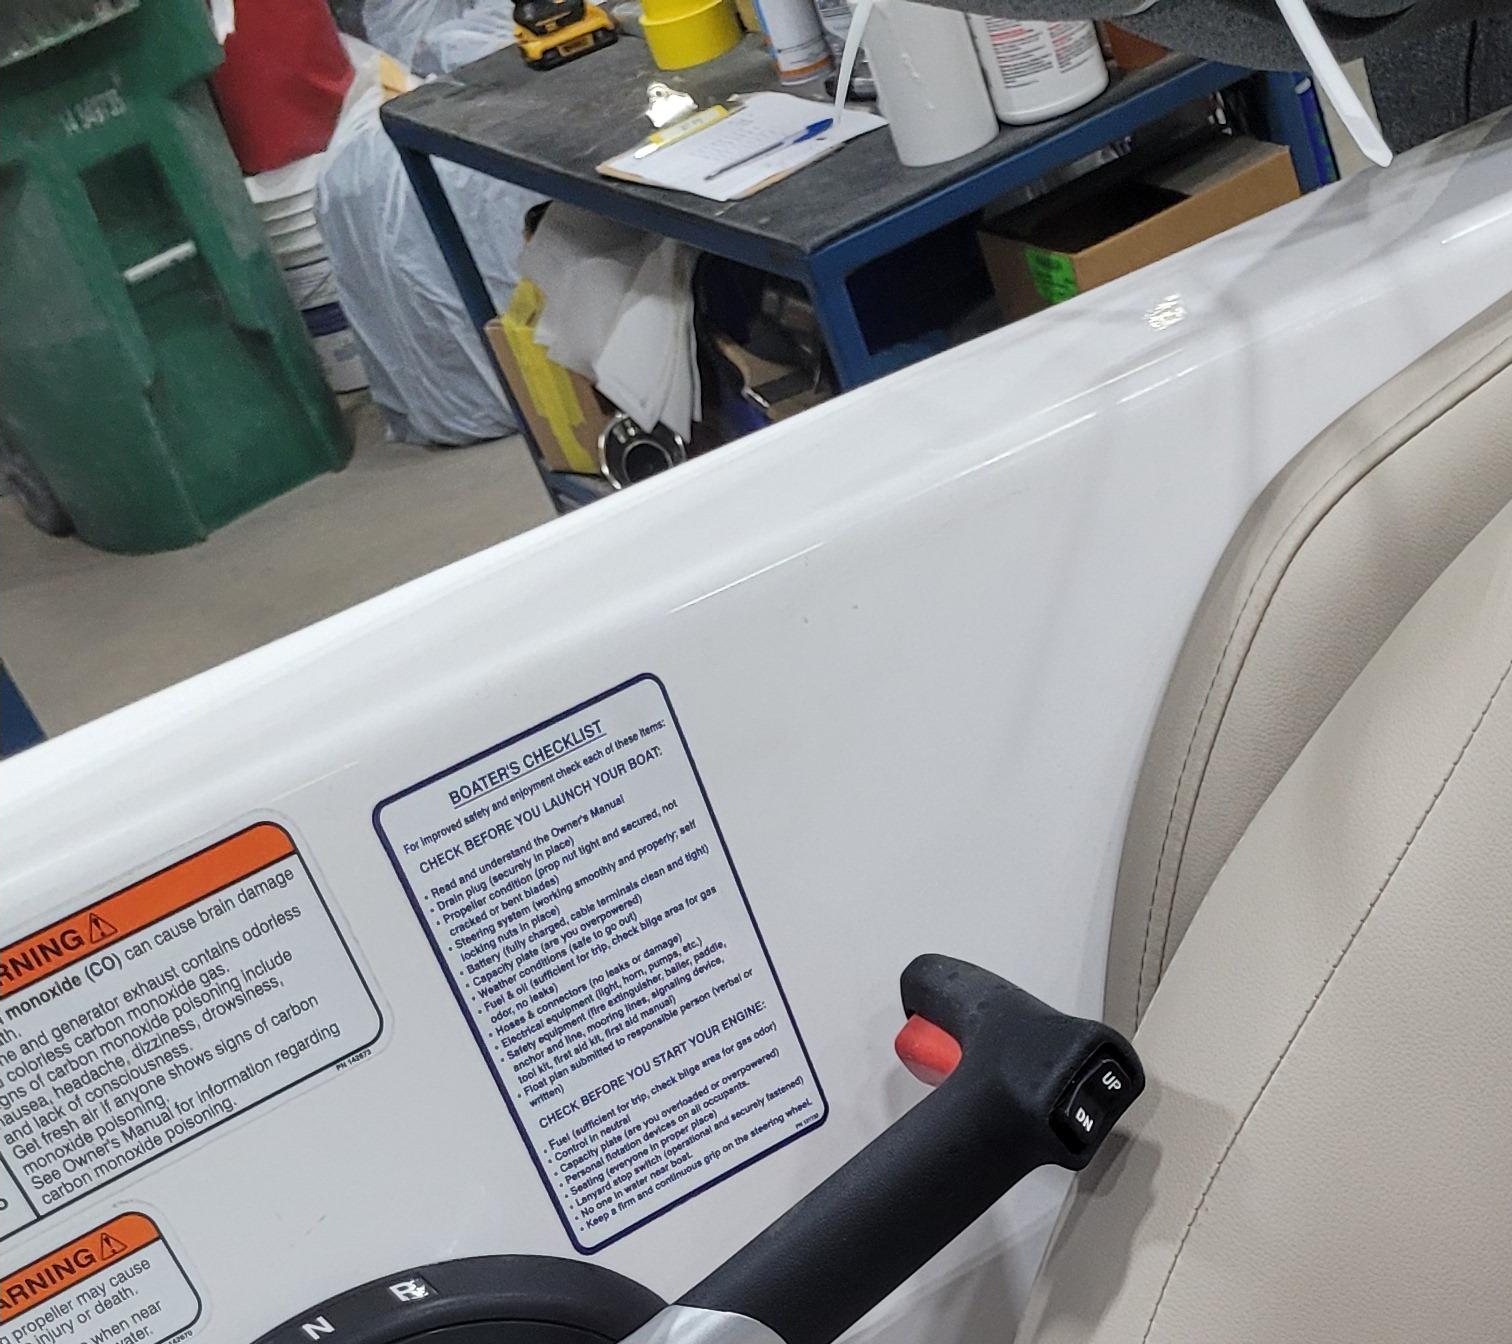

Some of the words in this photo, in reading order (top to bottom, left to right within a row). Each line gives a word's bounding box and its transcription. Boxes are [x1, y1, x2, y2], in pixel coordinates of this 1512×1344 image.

[402, 840, 420, 855] For
[418, 817, 463, 847] improved
[463, 805, 491, 826] safety
[491, 794, 510, 812] and
[509, 772, 556, 803] enjoyment
[555, 760, 583, 780] check
[582, 749, 605, 767] each
[604, 741, 615, 755] of
[614, 733, 639, 751] these
[638, 719, 667, 738] items:
[419, 843, 465, 874] CHECK
[463, 818, 516, 852] BEFORE
[513, 804, 542, 826] YOU
[541, 779, 593, 813] LAUNCH
[591, 762, 628, 787] YOUR
[627, 745, 663, 771] BOAT:
[447, 760, 521, 806] BOATER'S
[522, 718, 602, 769] CHECKLIST
[430, 877, 458, 899] Read
[458, 867, 478, 885] and
[478, 839, 533, 875] understand
[533, 833, 550, 847] the
[550, 814, 590, 838] Owner's
[589, 793, 626, 819] Manual
[435, 892, 465, 912] Drain
[464, 880, 488, 900] plug
[488, 857, 532, 887] (securely
[532, 852, 545, 863] in
[544, 835, 575, 860] place)
[442, 896, 487, 925] Propeller
[488, 873, 534, 901] condition
[534, 859, 561, 880] (prop
[561, 849, 579, 865] nut
[577, 837, 602, 856] tight
[601, 827, 620, 845] and
[620, 807, 662, 834] secured,
[661, 798, 679, 814] not
[4, 975, 83, 1021] monoxide
[84, 952, 123, 984] (CO)
[124, 940, 153, 961] can
[153, 917, 198, 946] cause
[196, 898, 237, 924] brain
[237, 868, 295, 904] damage
[449, 909, 489, 937] cracked
[488, 905, 500, 917] or
[500, 892, 524, 911] bent
[522, 874, 560, 899] blades)
[476, 973, 517, 999] Weather
[518, 948, 568, 979] conditions
[568, 935, 593, 955] (safe
[592, 929, 604, 940] to
[604, 922, 618, 937] go
[618, 910, 638, 927] out)
[5, 1042, 73, 1083] colorless
[73, 1015, 127, 1048] carbon
[125, 979, 197, 1022] monoxide
[198, 964, 231, 988] gas.
[19, 1029, 50, 1056] and
[50, 996, 120, 1043] generator
[122, 965, 180, 1003] exhaust
[180, 936, 241, 974] contains
[241, 905, 302, 943] odorless
[28, 1072, 46, 1092] of
[46, 1049, 100, 1083] carbon
[98, 1013, 170, 1056] monoxide
[170, 976, 243, 1022] poisoning
[239, 950, 293, 983] include
[12, 1137, 43, 1160] Get
[40, 1119, 81, 1146] fresh
[80, 1107, 100, 1126] air
[99, 1098, 113, 1115] if
[113, 1074, 167, 1109] anyone
[167, 1049, 214, 1080] shows
[214, 1029, 253, 1056] signs
[254, 1017, 269, 1035] of
[270, 995, 319, 1027] carbon
[51, 1056, 131, 1100] headache,
[131, 1019, 202, 1059] dizziness,
[201, 976, 285, 1023] drowsiness,
[538, 1099, 581, 1129] CHECK
[579, 1074, 628, 1107] BEFORE
[625, 1060, 652, 1081] YOU
[652, 1040, 688, 1068] START
[687, 1024, 721, 1048] YOUR
[720, 1000, 767, 1031] ENGINE:
[1102, 1071, 1122, 1090] UP
[2, 1120, 34, 1146] and
[32, 1105, 67, 1130] lack
[67, 1093, 84, 1112] of
[84, 1042, 194, 1103] consciousness.
[21, 1132, 95, 1176] monoxide
[94, 1094, 170, 1141] poisoning.
[30, 1169, 62, 1190] See
[62, 1137, 122, 1174] Owner's
[119, 1106, 175, 1144] Manual
[174, 1096, 195, 1116] for
[194, 1057, 274, 1104] information
[274, 1022, 341, 1064] regarding
[554, 1136, 589, 1162] Control
[588, 1133, 600, 1144] in
[599, 1113, 632, 1138] neutral
[559, 1146, 599, 1173] Capacity
[599, 1134, 623, 1154] plate
[623, 1124, 642, 1140] (are
[642, 1113, 661, 1130] you
[660, 1084, 710, 1118] overloaded
[710, 1080, 720, 1091] or
[721, 1047, 780, 1085] overpowered)
[1075, 1107, 1093, 1132] DN
[41, 1172, 93, 1205] carbon
[92, 1135, 164, 1178] monoxide
[163, 1097, 238, 1144] poisoning.
[580, 1206, 595, 1219] No
[595, 1196, 613, 1210] one
[612, 1190, 624, 1200] in
[623, 1175, 648, 1194] water
[649, 1163, 669, 1180] near
[669, 1151, 694, 1168] boat.
[11, 1299, 74, 1344] propeller
[75, 1282, 107, 1307] may
[108, 1259, 151, 1288] cause
[76, 1309, 92, 1324] or
[94, 1286, 139, 1315] death.
[130, 1300, 162, 1325] near
[302, 1316, 335, 1340] N
